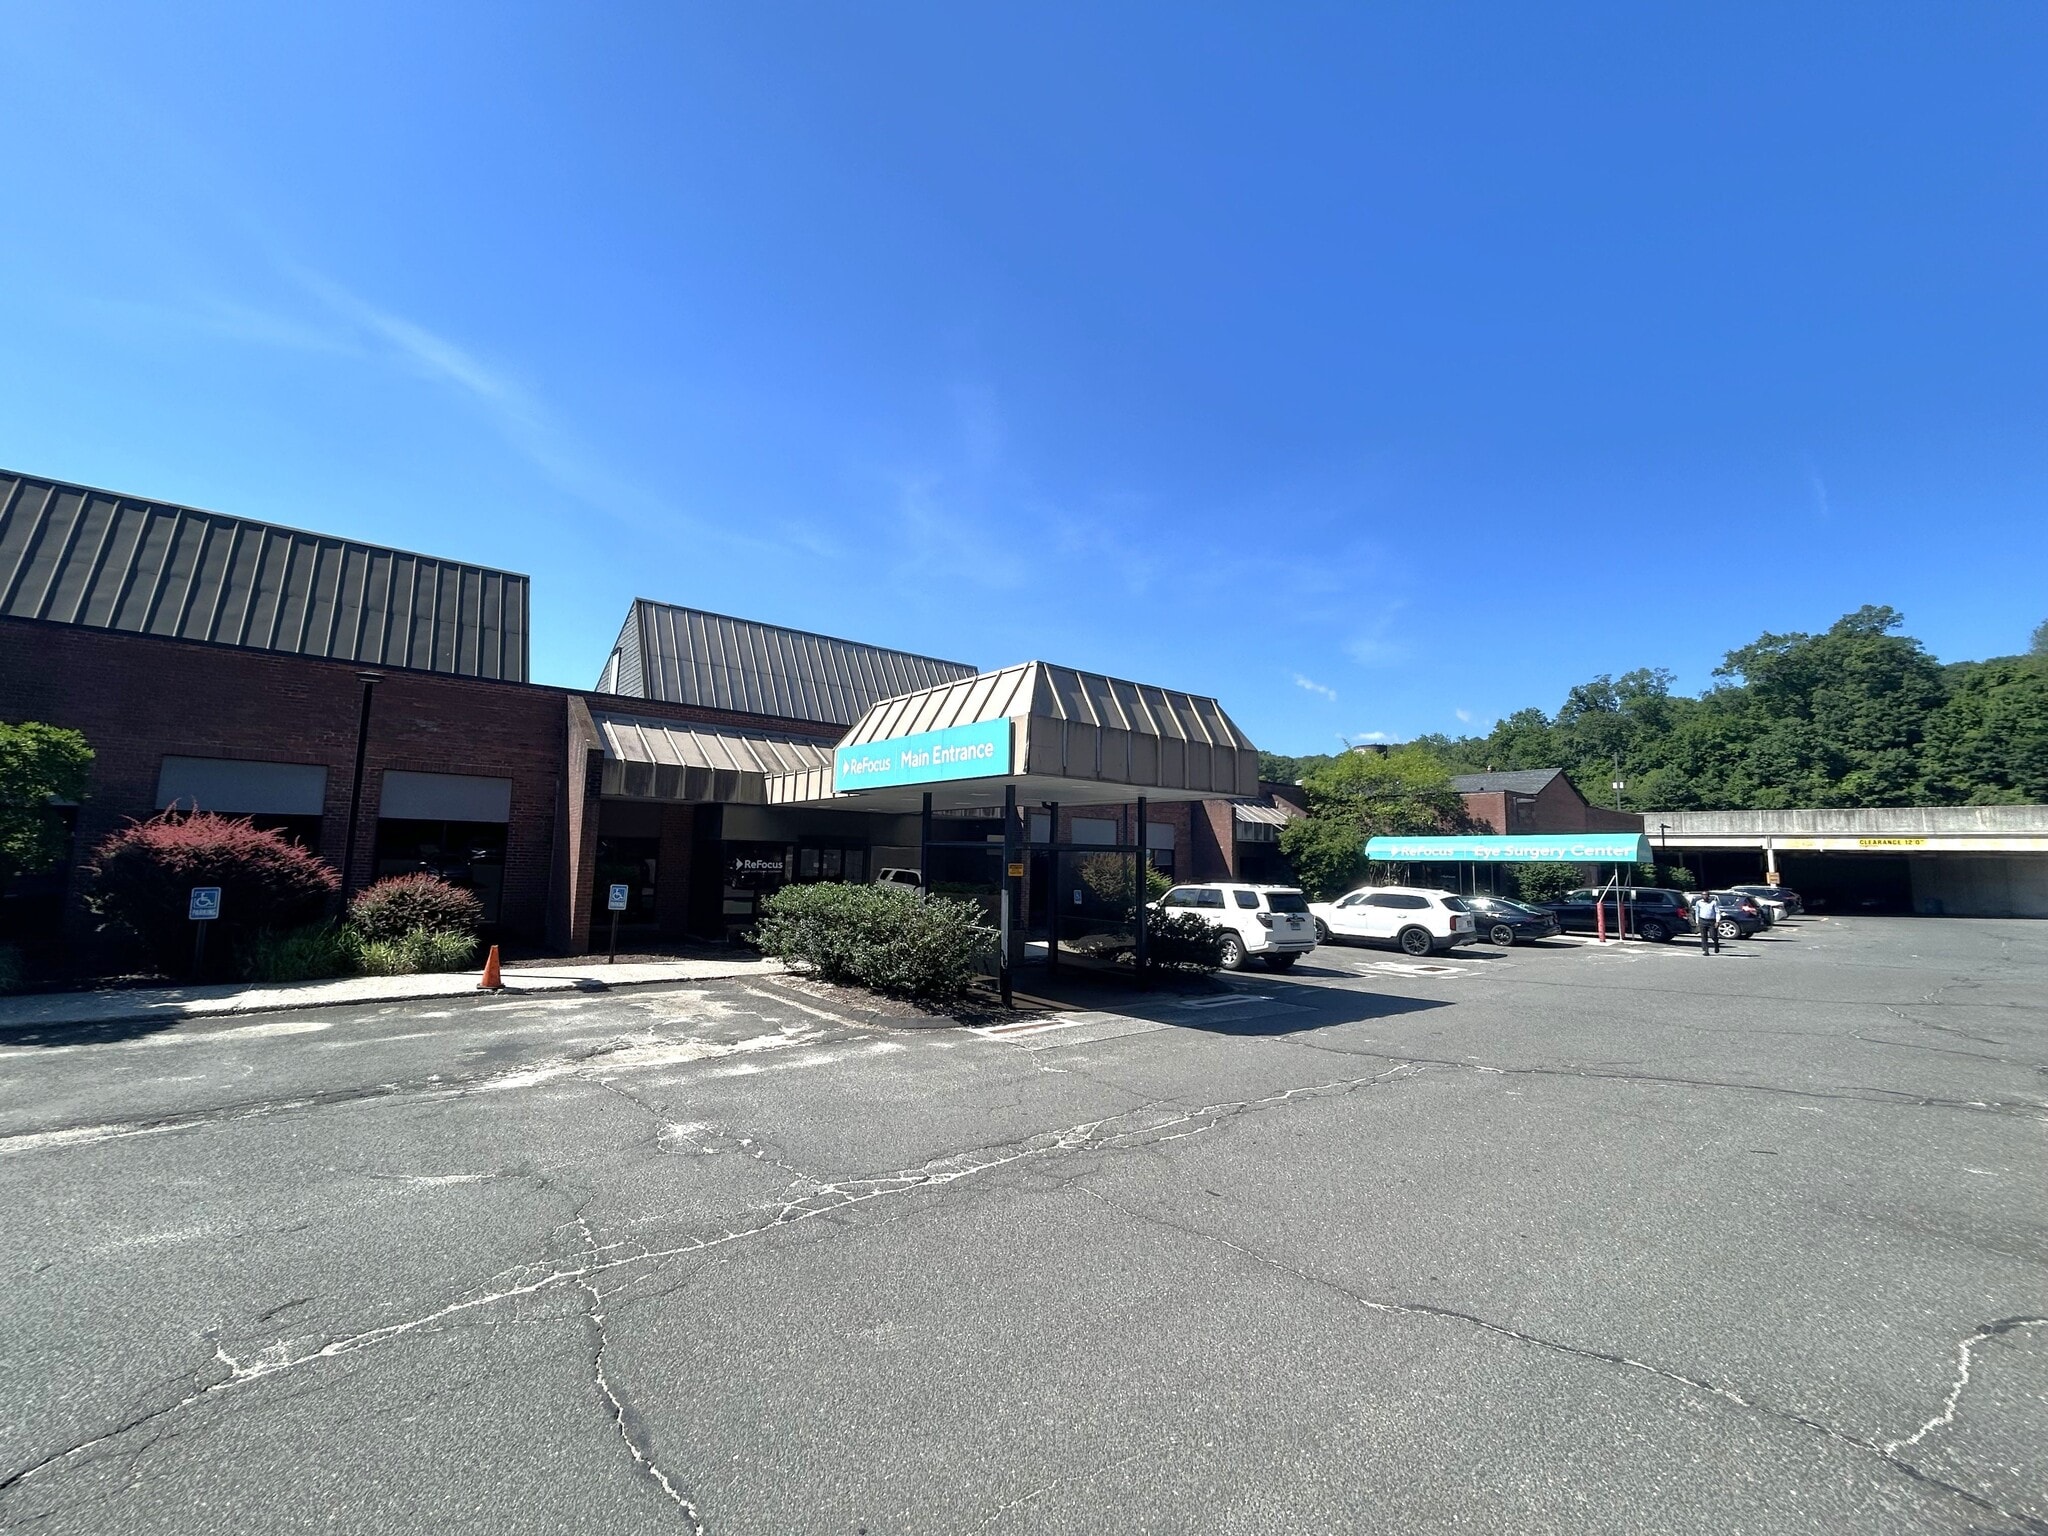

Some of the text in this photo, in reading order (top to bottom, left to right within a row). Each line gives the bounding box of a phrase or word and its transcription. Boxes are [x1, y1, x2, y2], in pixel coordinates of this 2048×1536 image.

[851, 742, 994, 775] ReFocus Main Entrance
[1401, 844, 1631, 860] ReFocus Eye Surgery Center
[744, 859, 783, 869] ReFocus
